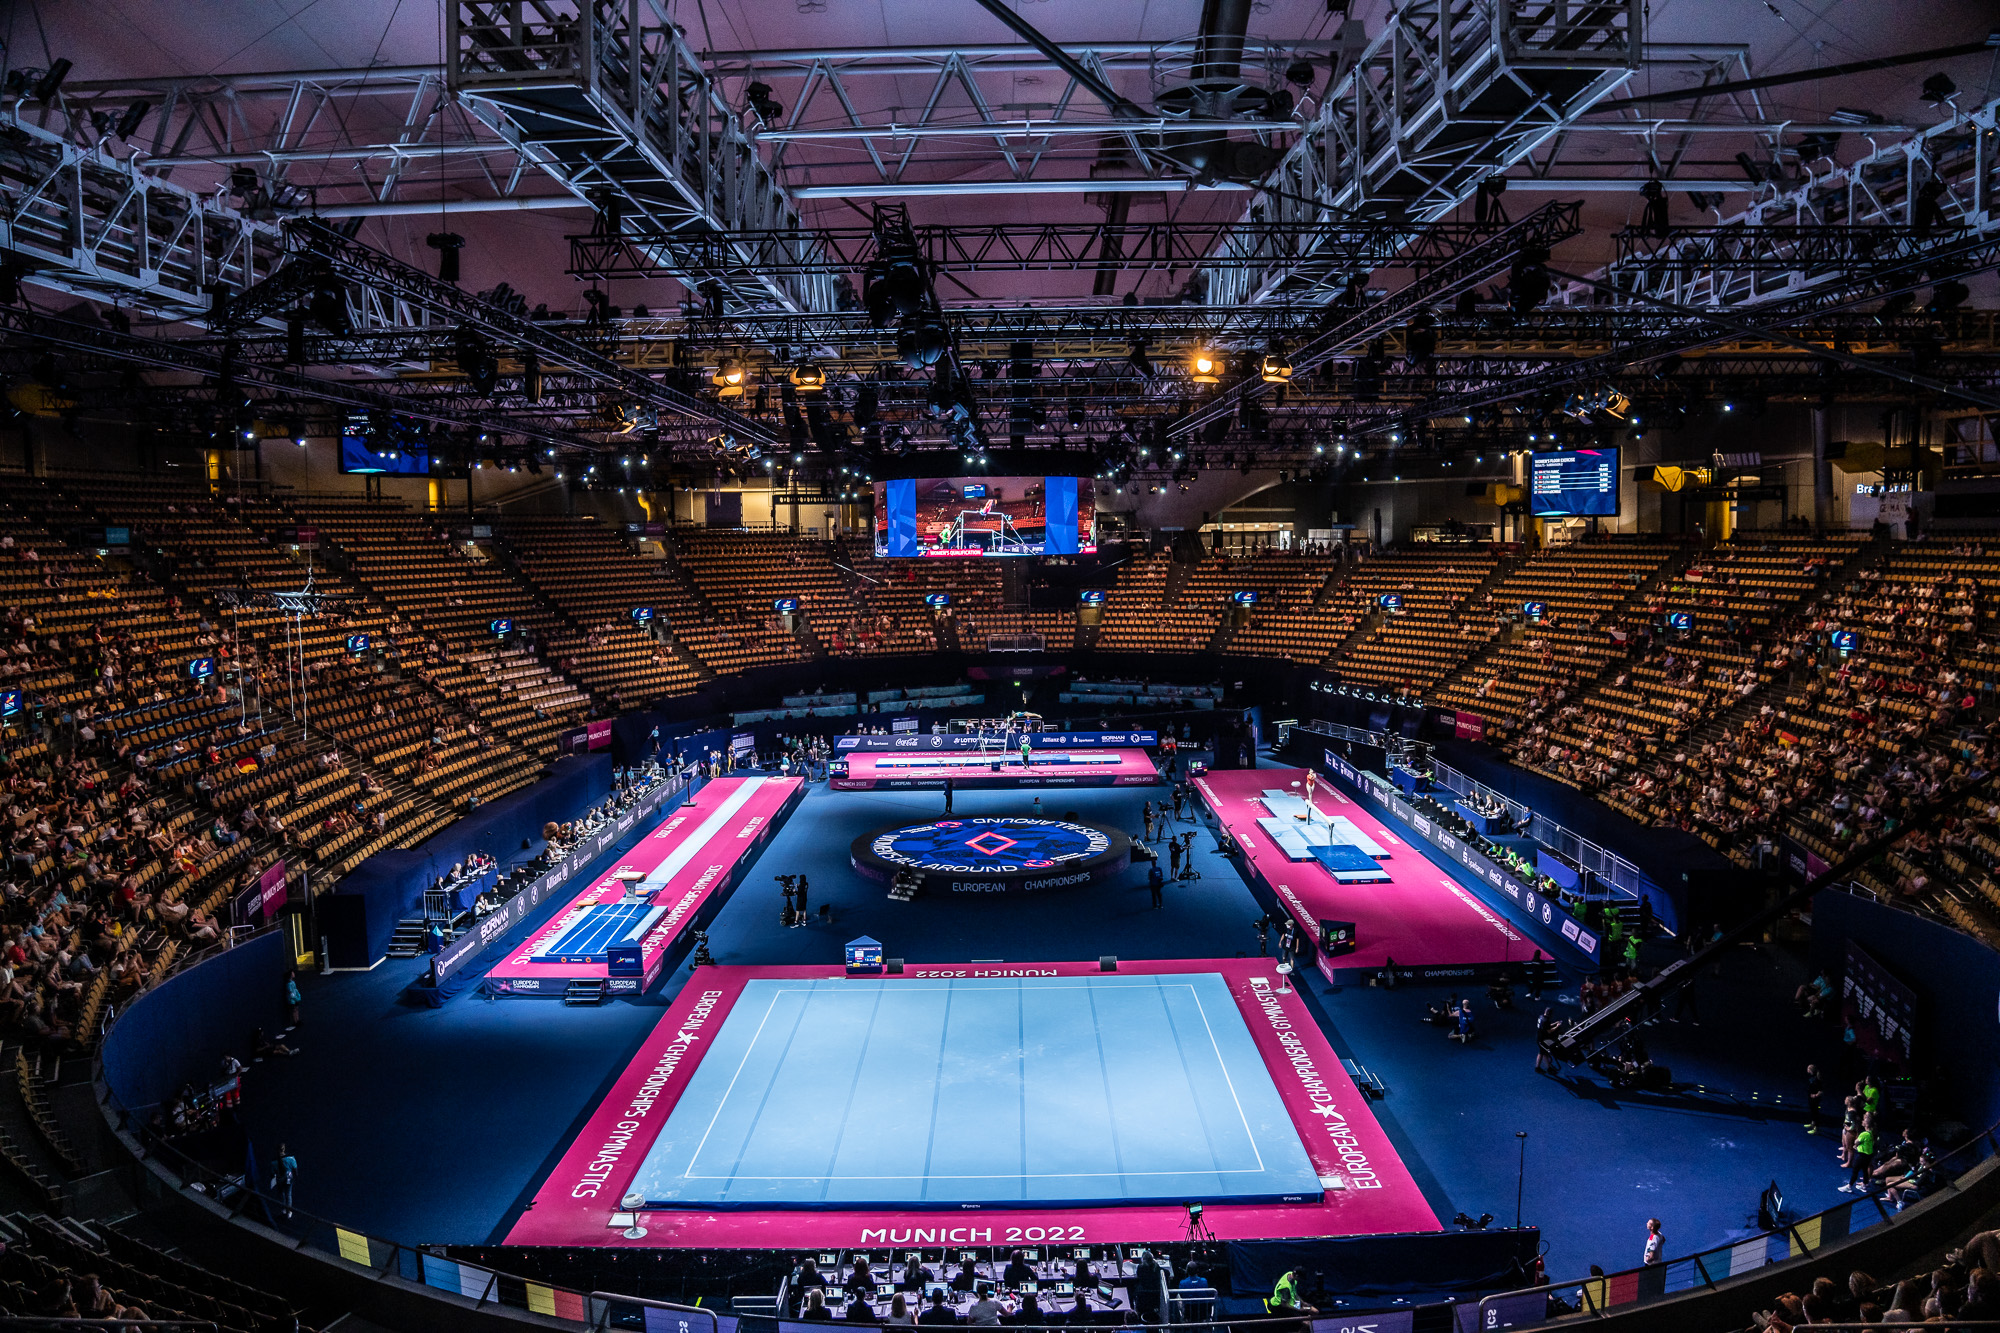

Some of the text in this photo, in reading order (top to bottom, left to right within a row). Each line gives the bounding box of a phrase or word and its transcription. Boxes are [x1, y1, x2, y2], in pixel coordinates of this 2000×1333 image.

[1456, 721, 1471, 730] MUNICH
[589, 732, 602, 740] MUNICH
[972, 818, 1057, 826] AROUND
[922, 864, 1018, 872] AROUND
[546, 872, 562, 891] Allianz
[953, 872, 1090, 892] EUROPEAN CHAMPIONSHIPS
[662, 890, 702, 930] CHAMPIONSHIPS
[694, 864, 723, 893] GYMNASTICS
[480, 907, 508, 938] BORNAN
[1425, 969, 1475, 977] CHAMPIONSHIPS
[571, 990, 722, 1198] EUROPEAN CHAMPIONSHIPS GYMNASTICS
[1250, 982, 1382, 1189] EUROPEAN CHAMPIONSHIPS GYMNASTICS
[860, 1226, 1086, 1243] MUNICH 2022
